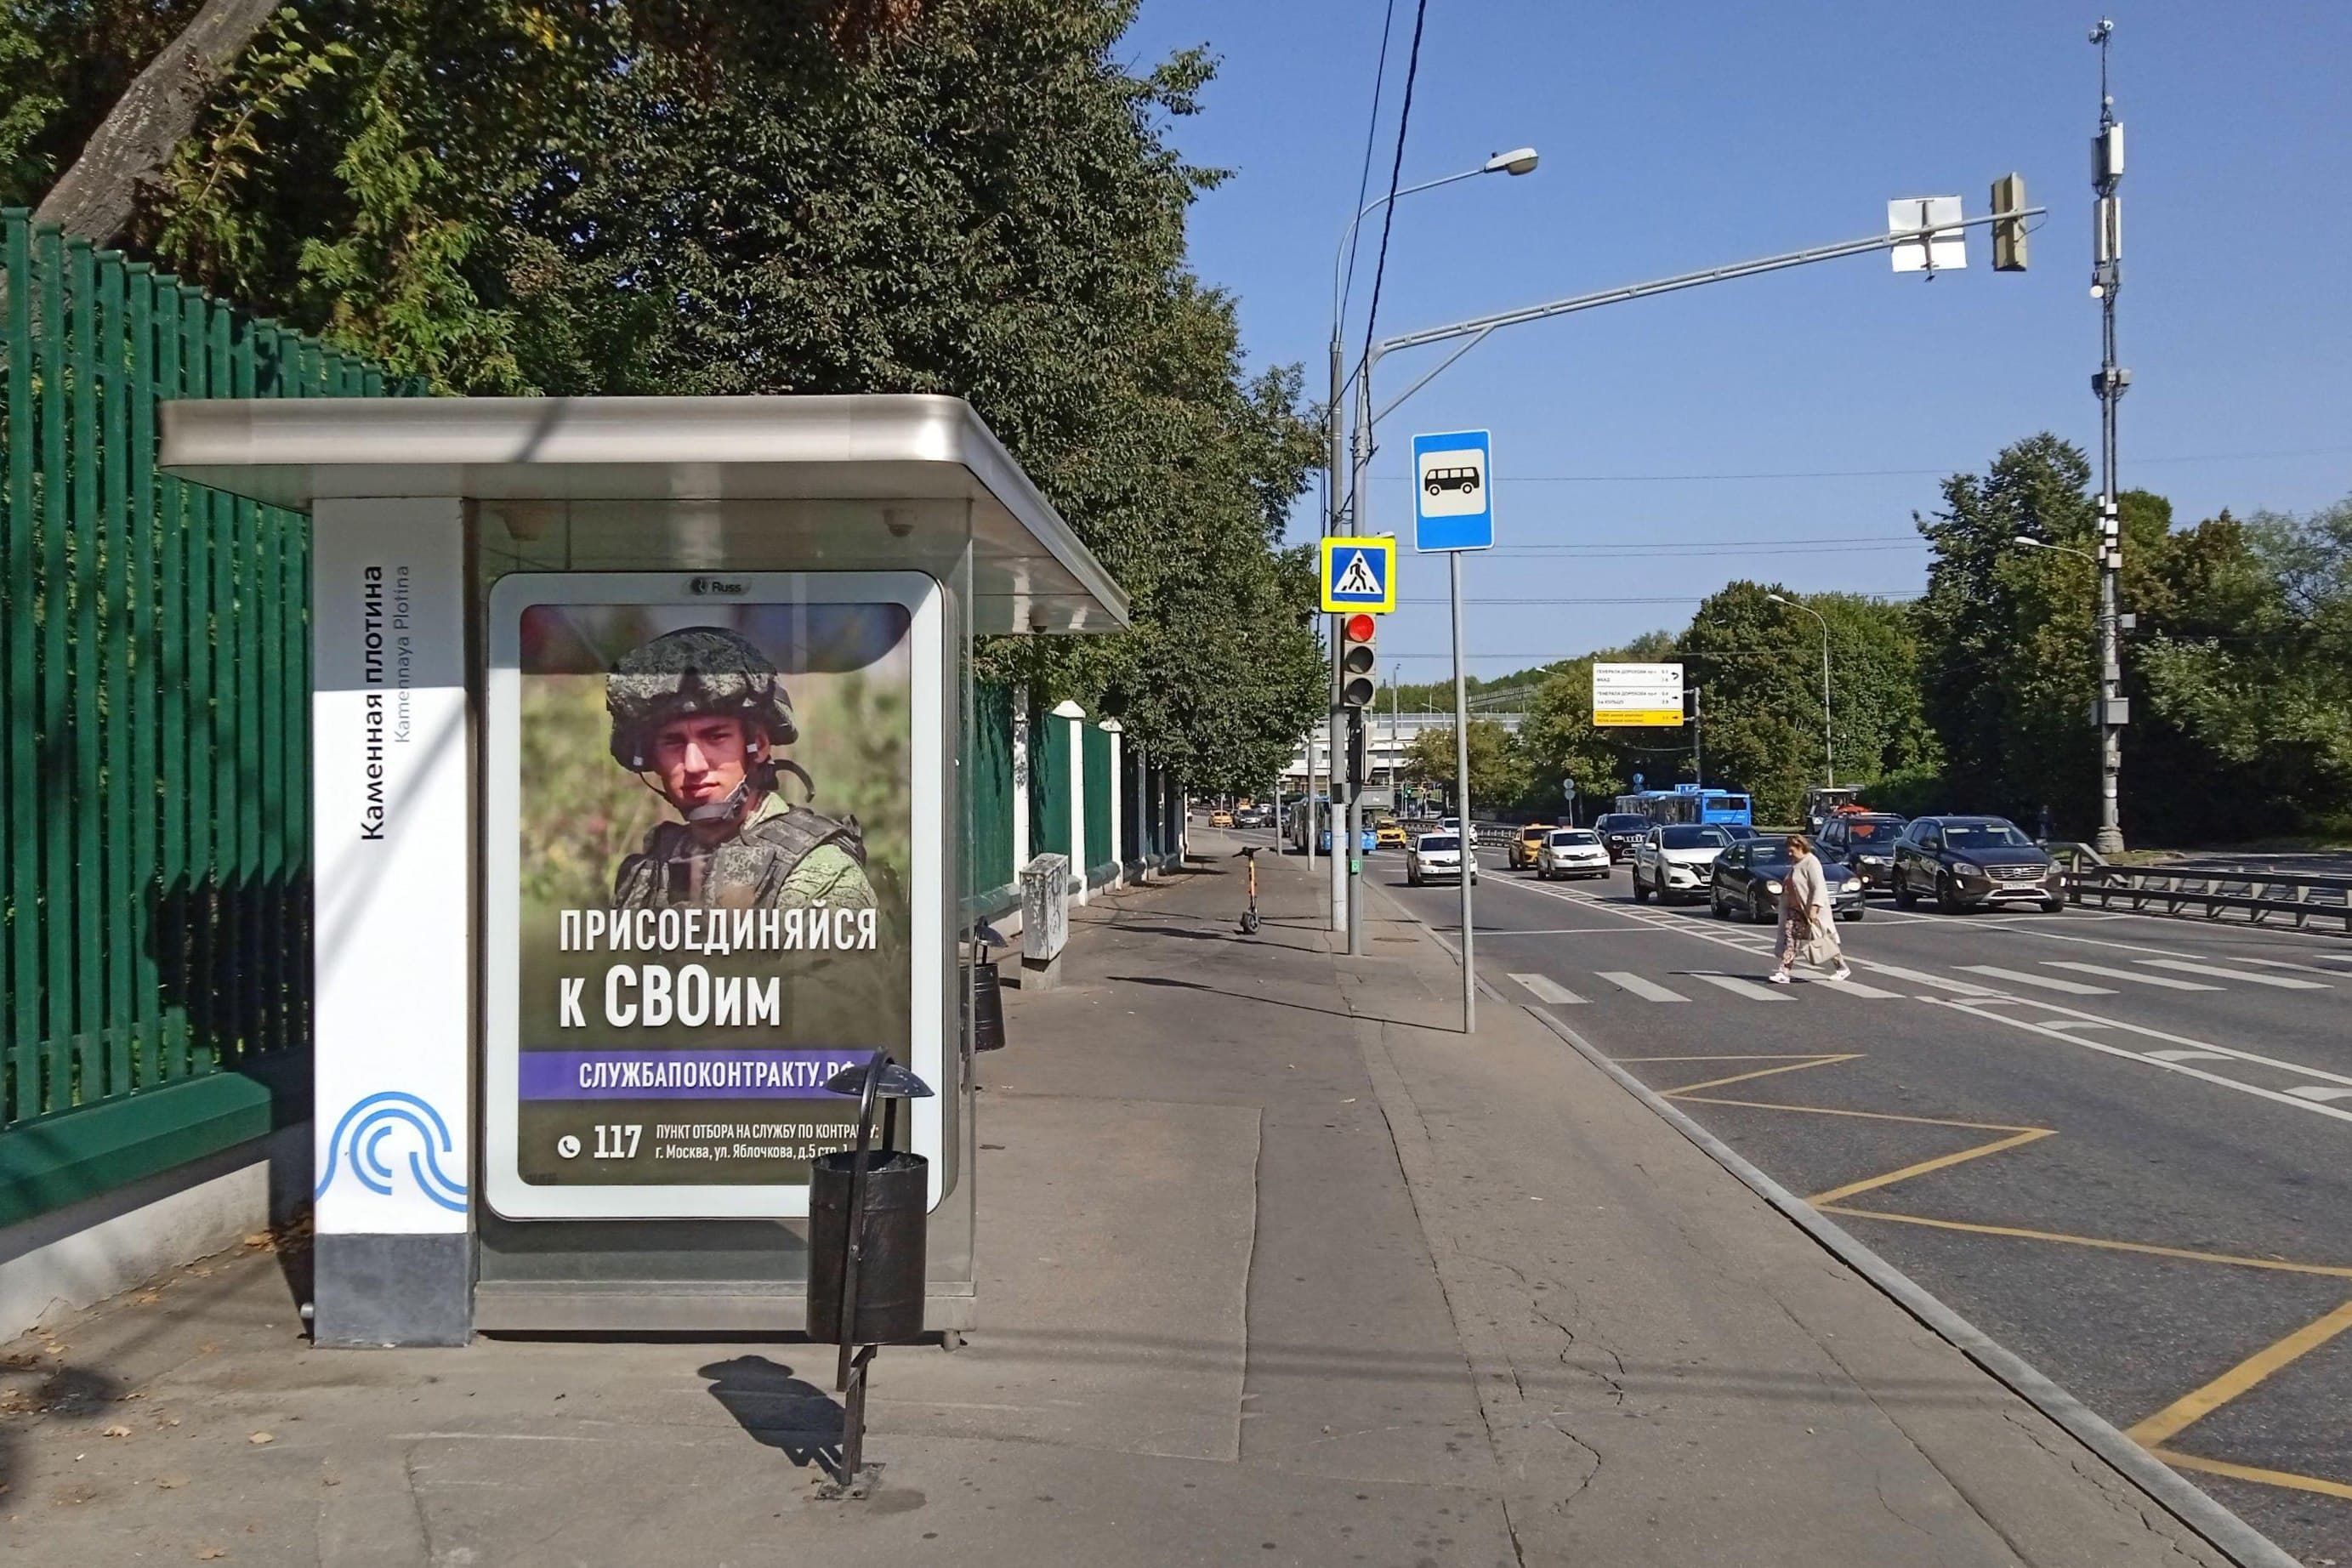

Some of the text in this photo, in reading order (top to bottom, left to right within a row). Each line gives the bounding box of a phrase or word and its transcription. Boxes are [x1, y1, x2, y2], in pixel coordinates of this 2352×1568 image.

[712, 582, 741, 593] Russ
[393, 565, 413, 742] Kamennaya Plotina
[361, 565, 384, 840] Каменная плотина
[560, 899, 878, 956] ПРИСОЕДИНЯЙСЯ
[594, 1124, 643, 1159] 117
[656, 1124, 691, 1139] ПУНКТ
[692, 1123, 735, 1139] ОТБОРА
[736, 1123, 751, 1139] НА
[753, 1123, 796, 1139] СЛУЖБУ
[798, 1123, 814, 1139] ПО
[655, 1146, 664, 1159] г.
[666, 1144, 713, 1161] Москва,
[714, 1146, 731, 1162] ул.
[732, 1144, 797, 1161] Яблочкова,
